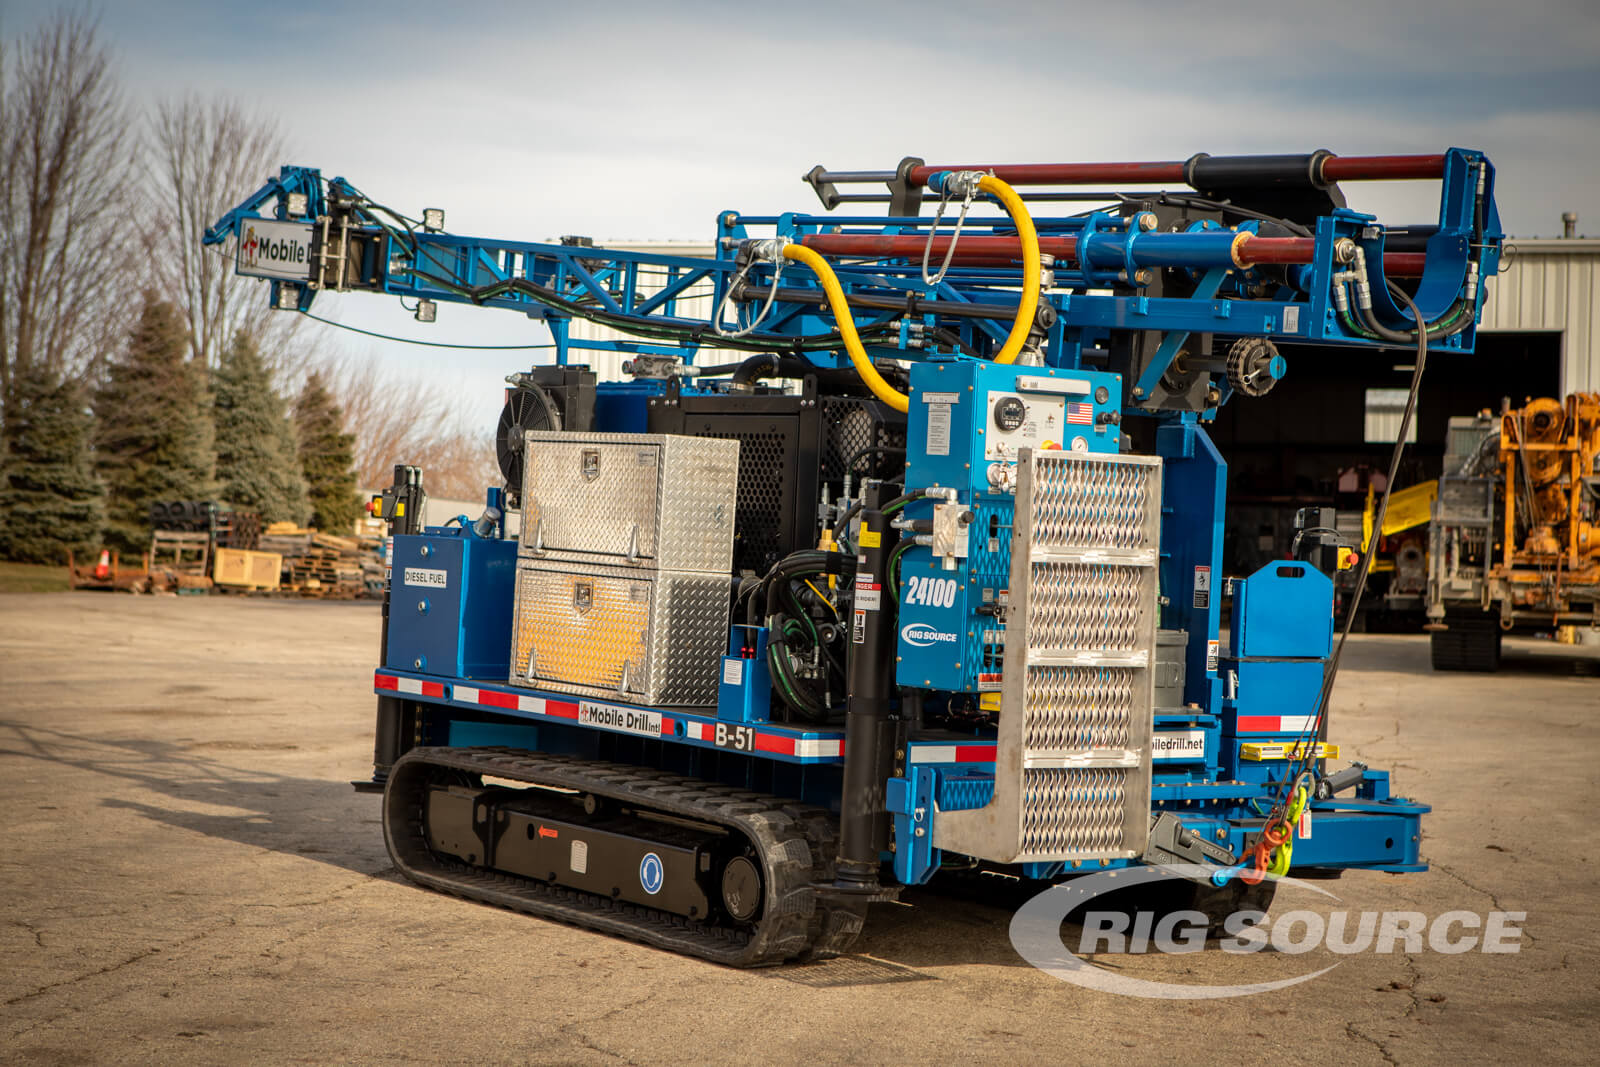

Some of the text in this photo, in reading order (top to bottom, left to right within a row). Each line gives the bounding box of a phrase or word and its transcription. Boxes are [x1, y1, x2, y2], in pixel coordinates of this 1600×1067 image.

[258, 237, 304, 263] Mobile
[405, 571, 446, 584] DIESEL FUEL
[905, 576, 956, 608] 24100
[908, 630, 957, 642] RIG SOURCE
[589, 706, 623, 727] Mobile
[626, 712, 649, 731] Drill
[715, 723, 753, 751] B-51
